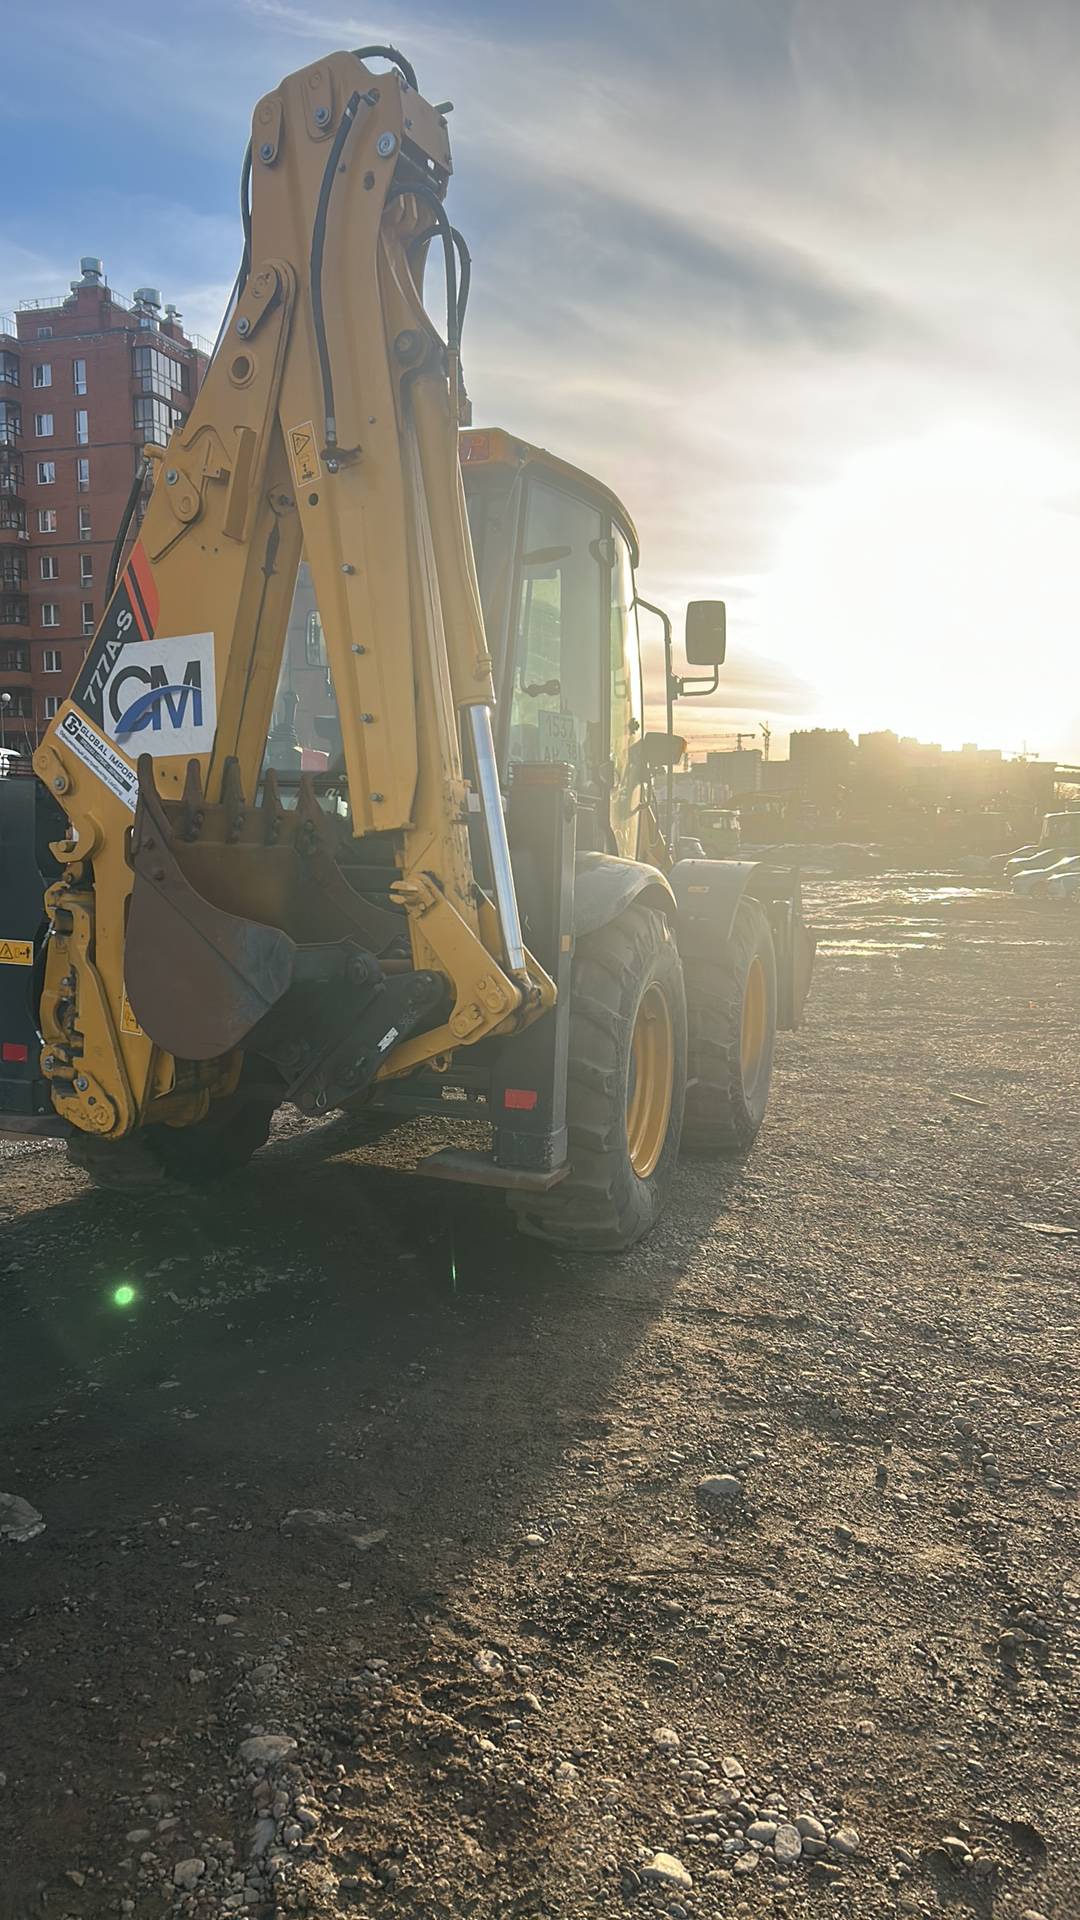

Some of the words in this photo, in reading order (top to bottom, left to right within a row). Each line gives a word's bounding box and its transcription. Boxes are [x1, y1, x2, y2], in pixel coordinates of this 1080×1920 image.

[83, 609, 133, 704] 777A-S
[80, 726, 107, 756] GLOBAL
[109, 754, 137, 784] IMPORT
